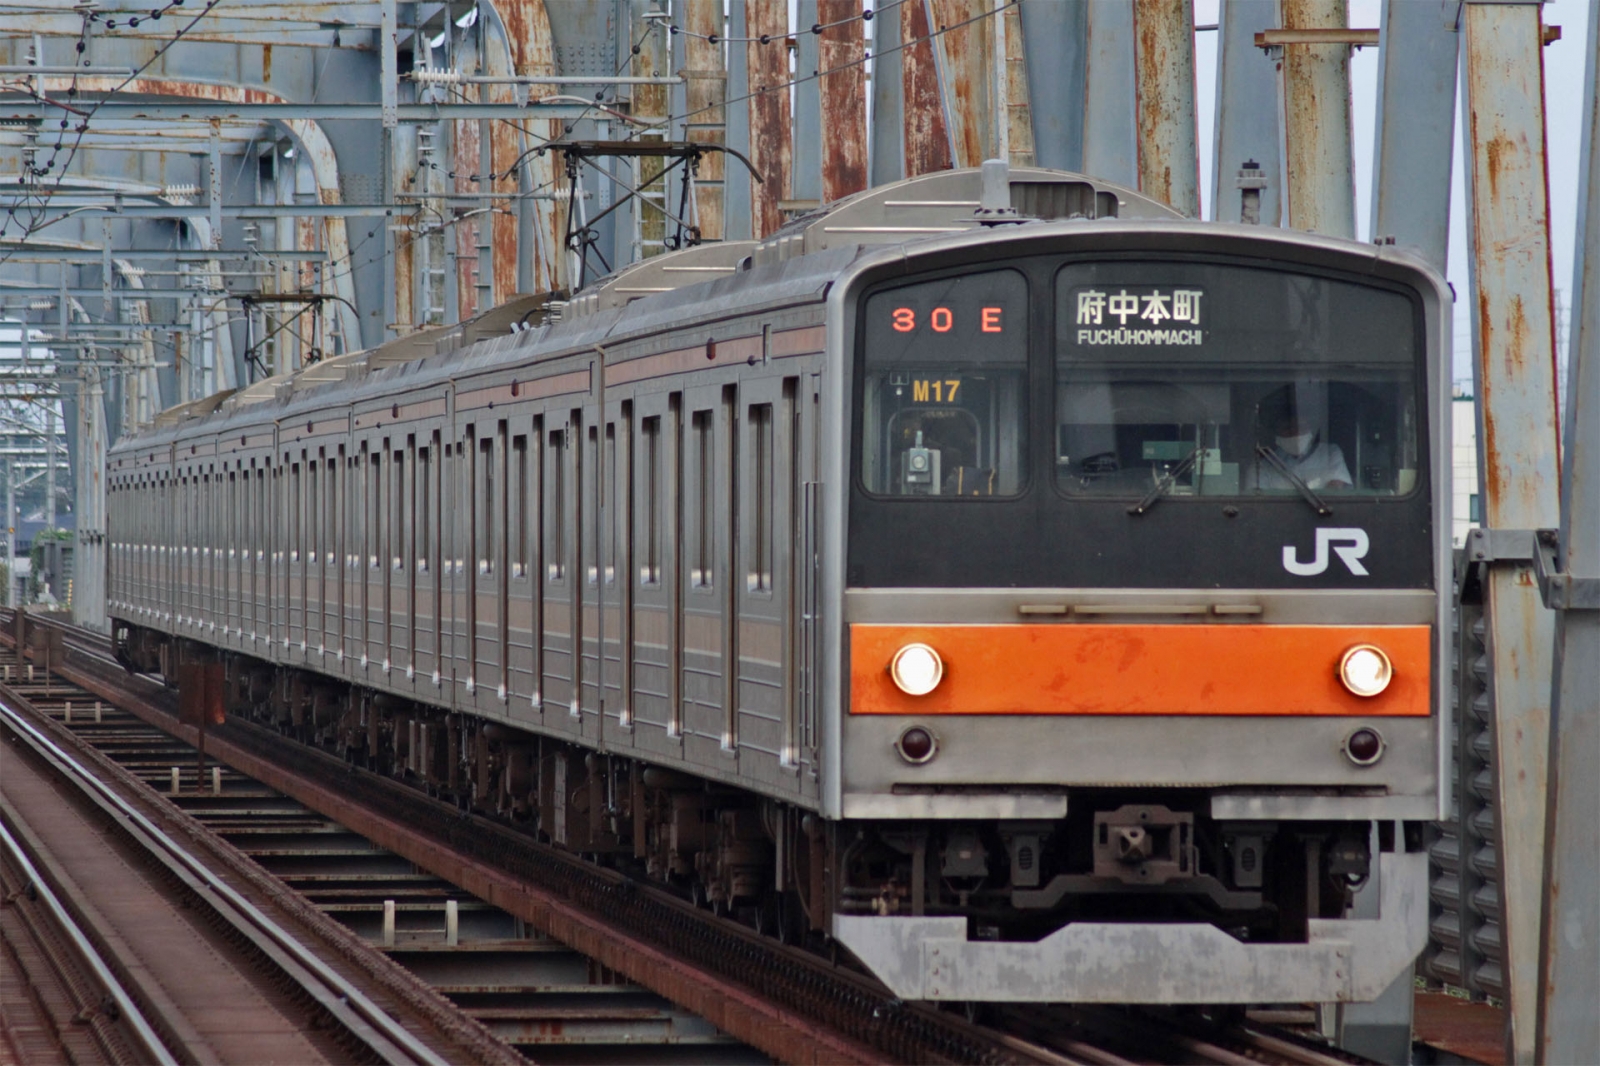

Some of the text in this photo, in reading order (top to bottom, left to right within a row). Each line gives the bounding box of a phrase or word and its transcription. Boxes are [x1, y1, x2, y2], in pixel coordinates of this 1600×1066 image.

[1076, 289, 1204, 325] 府中本町
[1077, 327, 1202, 345] FUCHŪHOMMACHI
[913, 379, 960, 402] M17
[1282, 527, 1370, 576] JR
